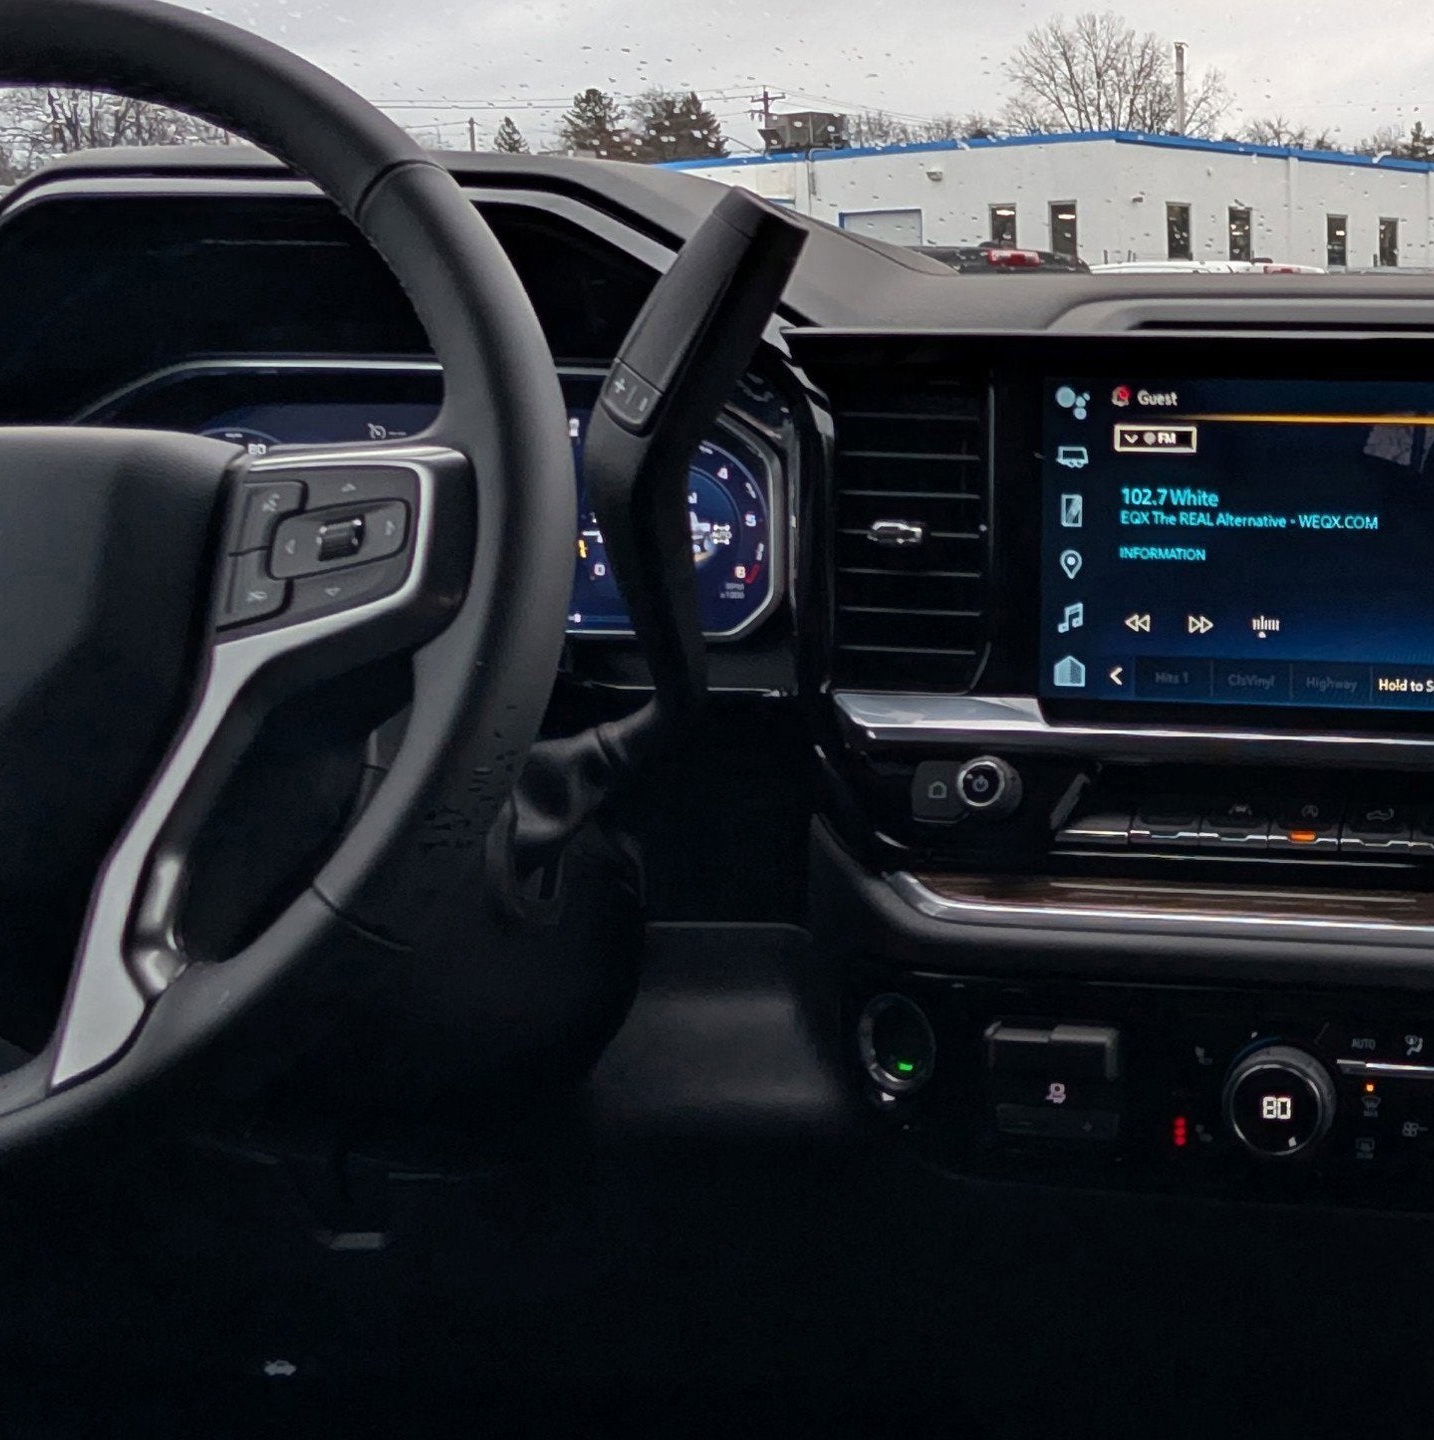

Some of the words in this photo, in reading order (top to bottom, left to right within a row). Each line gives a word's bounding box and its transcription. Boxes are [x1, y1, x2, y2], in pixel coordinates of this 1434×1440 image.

[1137, 390, 1178, 407] Guest
[1157, 432, 1177, 445] FM
[1121, 487, 1168, 506] 102.7
[1170, 489, 1220, 508] White
[1120, 511, 1150, 526] EQX
[1152, 511, 1177, 526] The
[1179, 512, 1214, 527] REAL
[1216, 513, 1287, 529] Alternative
[1298, 514, 1379, 530] WEQX.COM
[1119, 547, 1207, 561] INFORMATION
[1155, 671, 1180, 685] Hits
[1306, 676, 1358, 693] Highway
[1378, 678, 1408, 692] Hold
[1410, 680, 1424, 692] to
[1351, 1038, 1376, 1050] AUTO
[1262, 1096, 1292, 1120] 80
